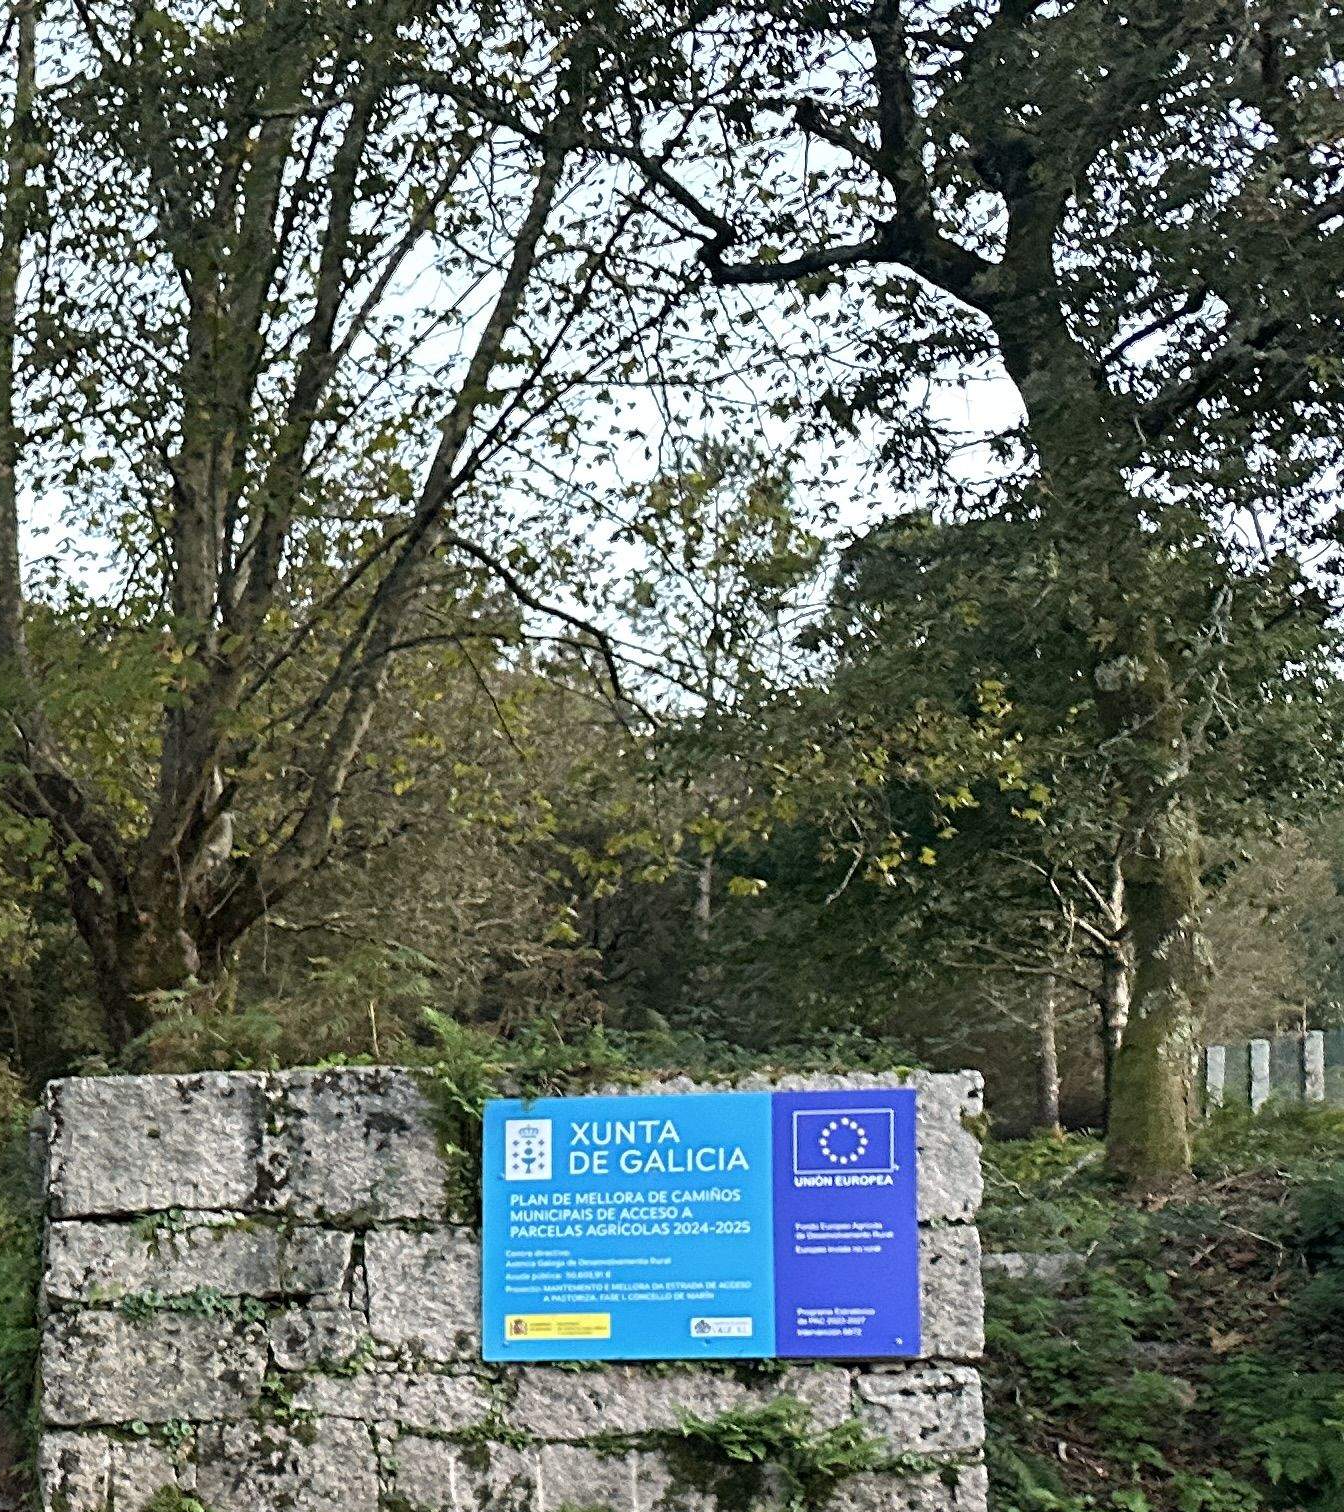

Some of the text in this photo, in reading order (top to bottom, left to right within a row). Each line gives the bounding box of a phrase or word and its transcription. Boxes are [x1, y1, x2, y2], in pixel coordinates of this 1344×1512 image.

[570, 1120, 680, 1146] XUNTA
[570, 1147, 749, 1175] DE GALICIA
[794, 1174, 894, 1187] UNIÓN EUROPEA
[510, 1187, 741, 1206] PLAN DE MELLORA DE CAMIÑOS
[510, 1206, 692, 1222] MUNICIPAIS DE ACCESO A
[510, 1220, 750, 1238] PARCELAS AGRÍCOLAS 2024-2025
